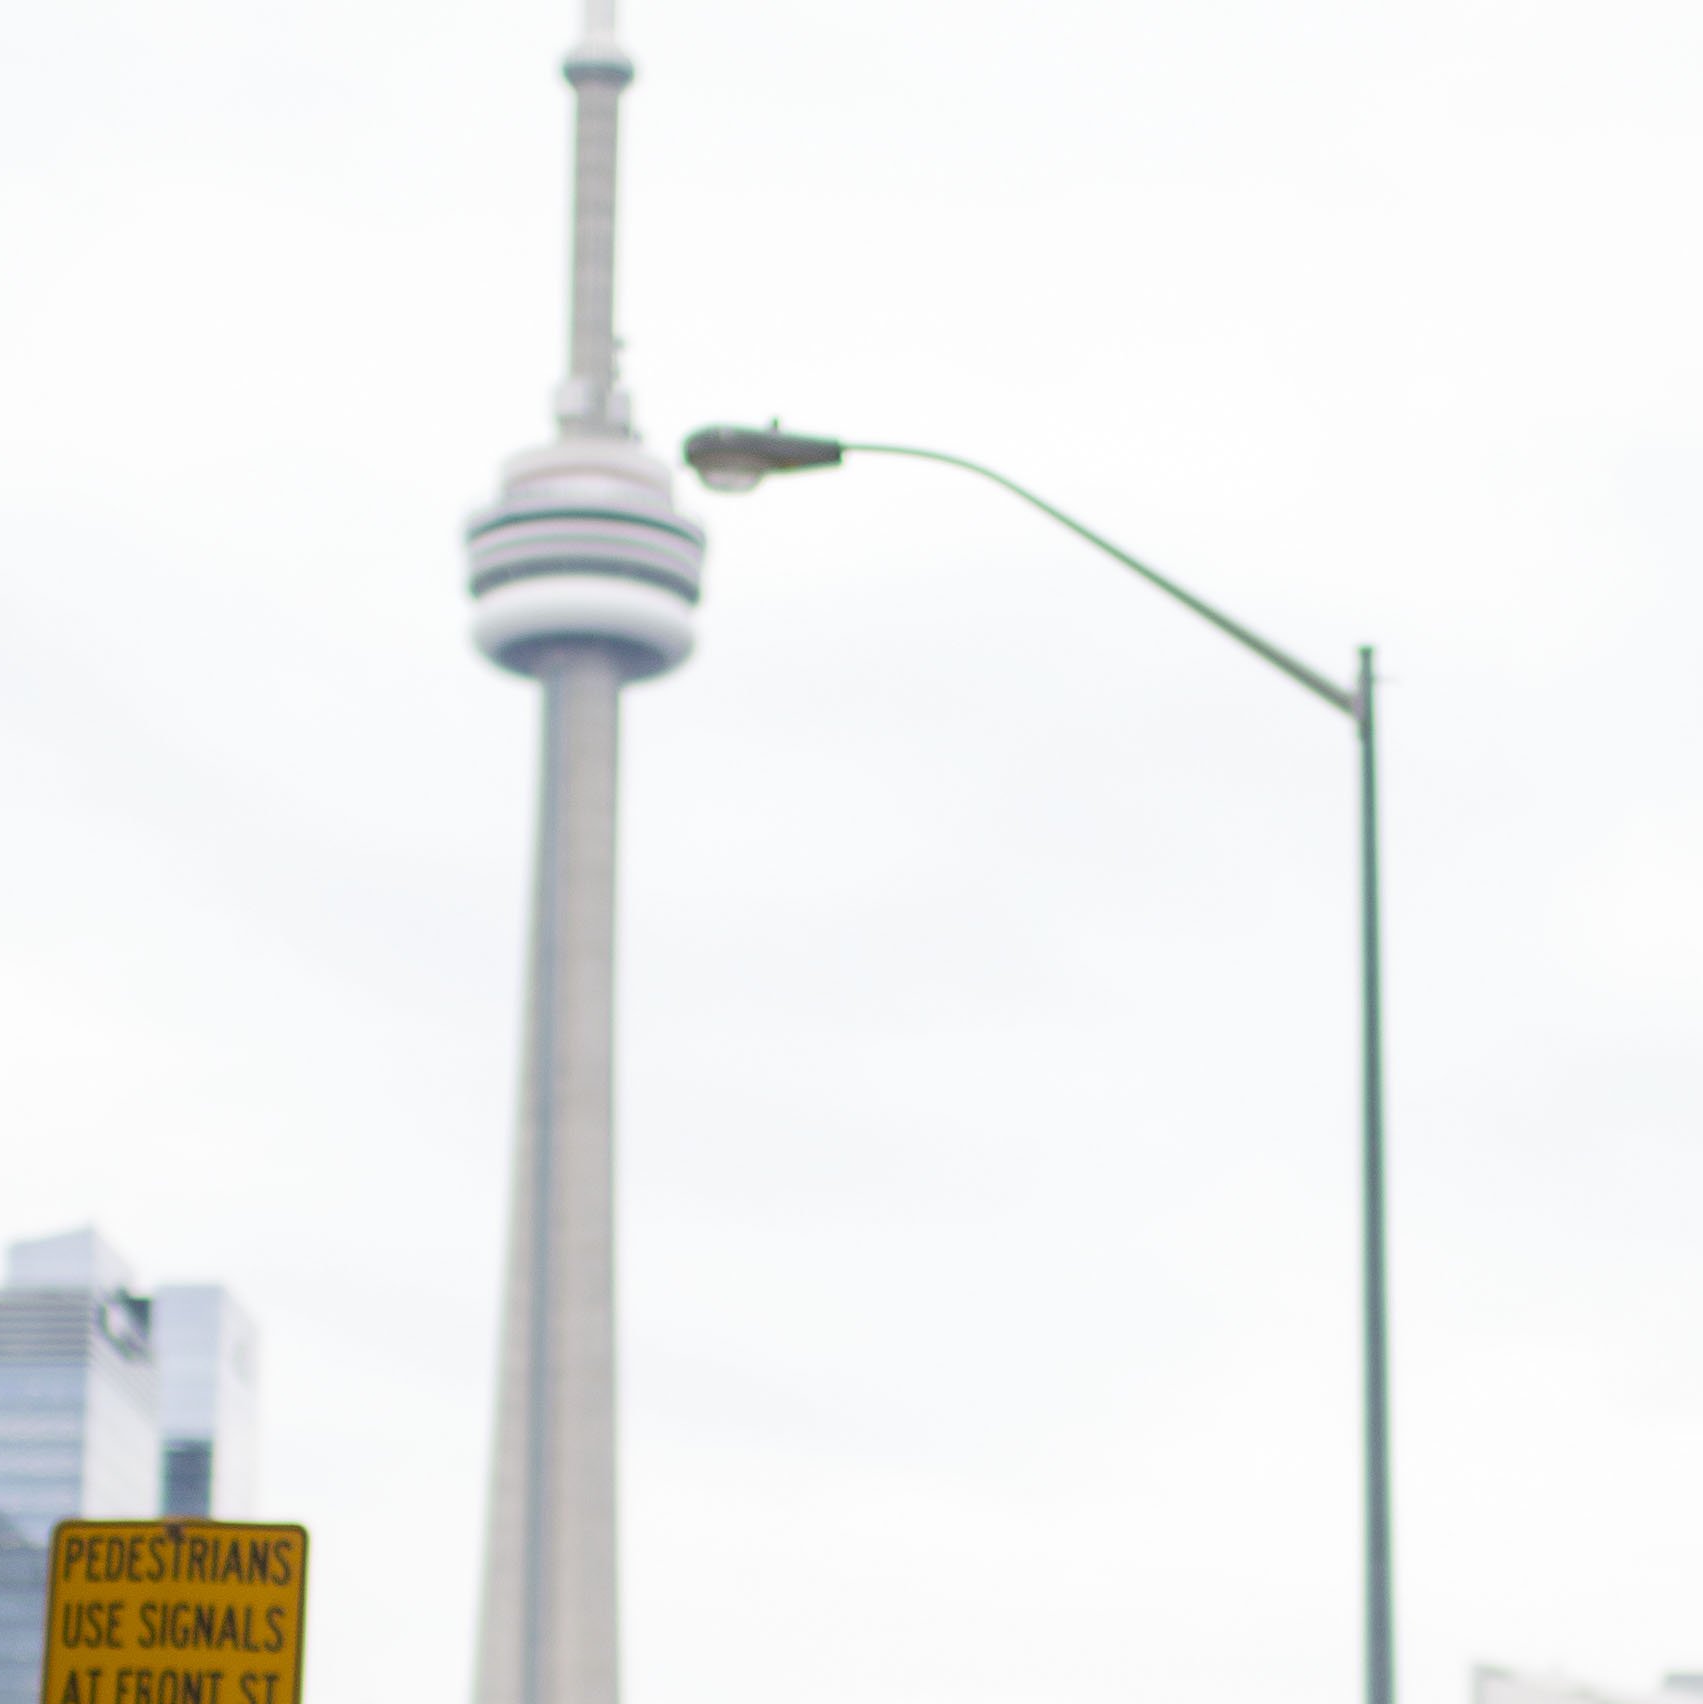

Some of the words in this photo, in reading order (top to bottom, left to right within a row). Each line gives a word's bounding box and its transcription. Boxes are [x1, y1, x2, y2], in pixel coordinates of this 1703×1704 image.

[62, 1536, 293, 1586] PEDESTRIANS
[62, 1602, 124, 1649] USE
[138, 1603, 286, 1652] SIGNALS
